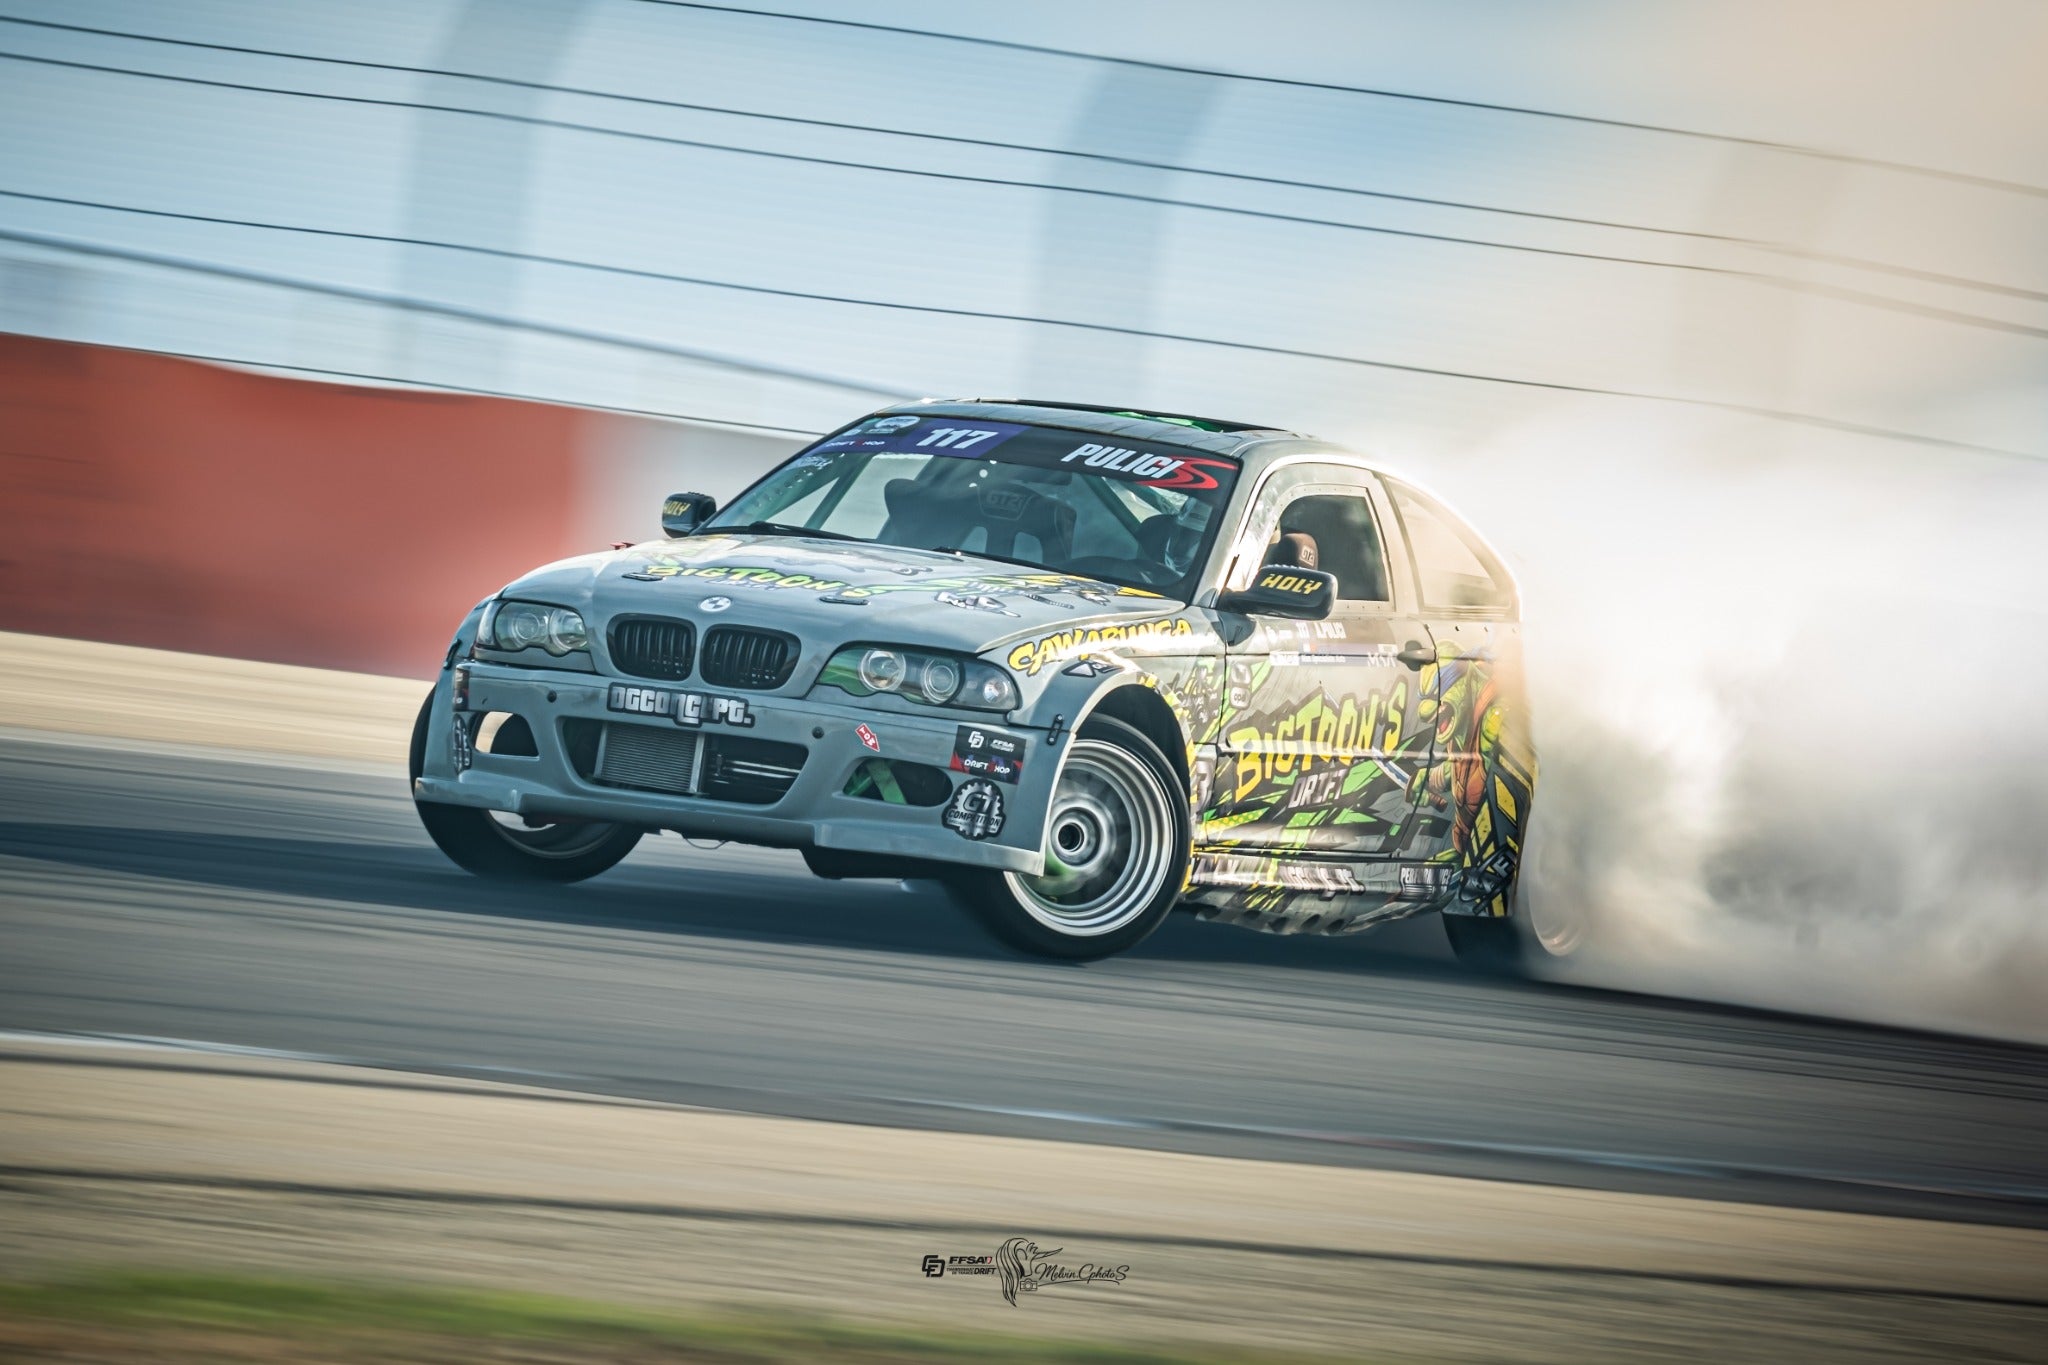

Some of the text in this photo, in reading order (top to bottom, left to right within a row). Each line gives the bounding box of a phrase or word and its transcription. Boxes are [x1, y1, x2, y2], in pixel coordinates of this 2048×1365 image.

[916, 427, 998, 450] 117
[1060, 443, 1183, 479] PULICI
[1260, 573, 1323, 595] HOLY
[858, 726, 876, 746] TOW
[1287, 768, 1348, 809] DRIFT
[948, 809, 1001, 827] COMPETITON
